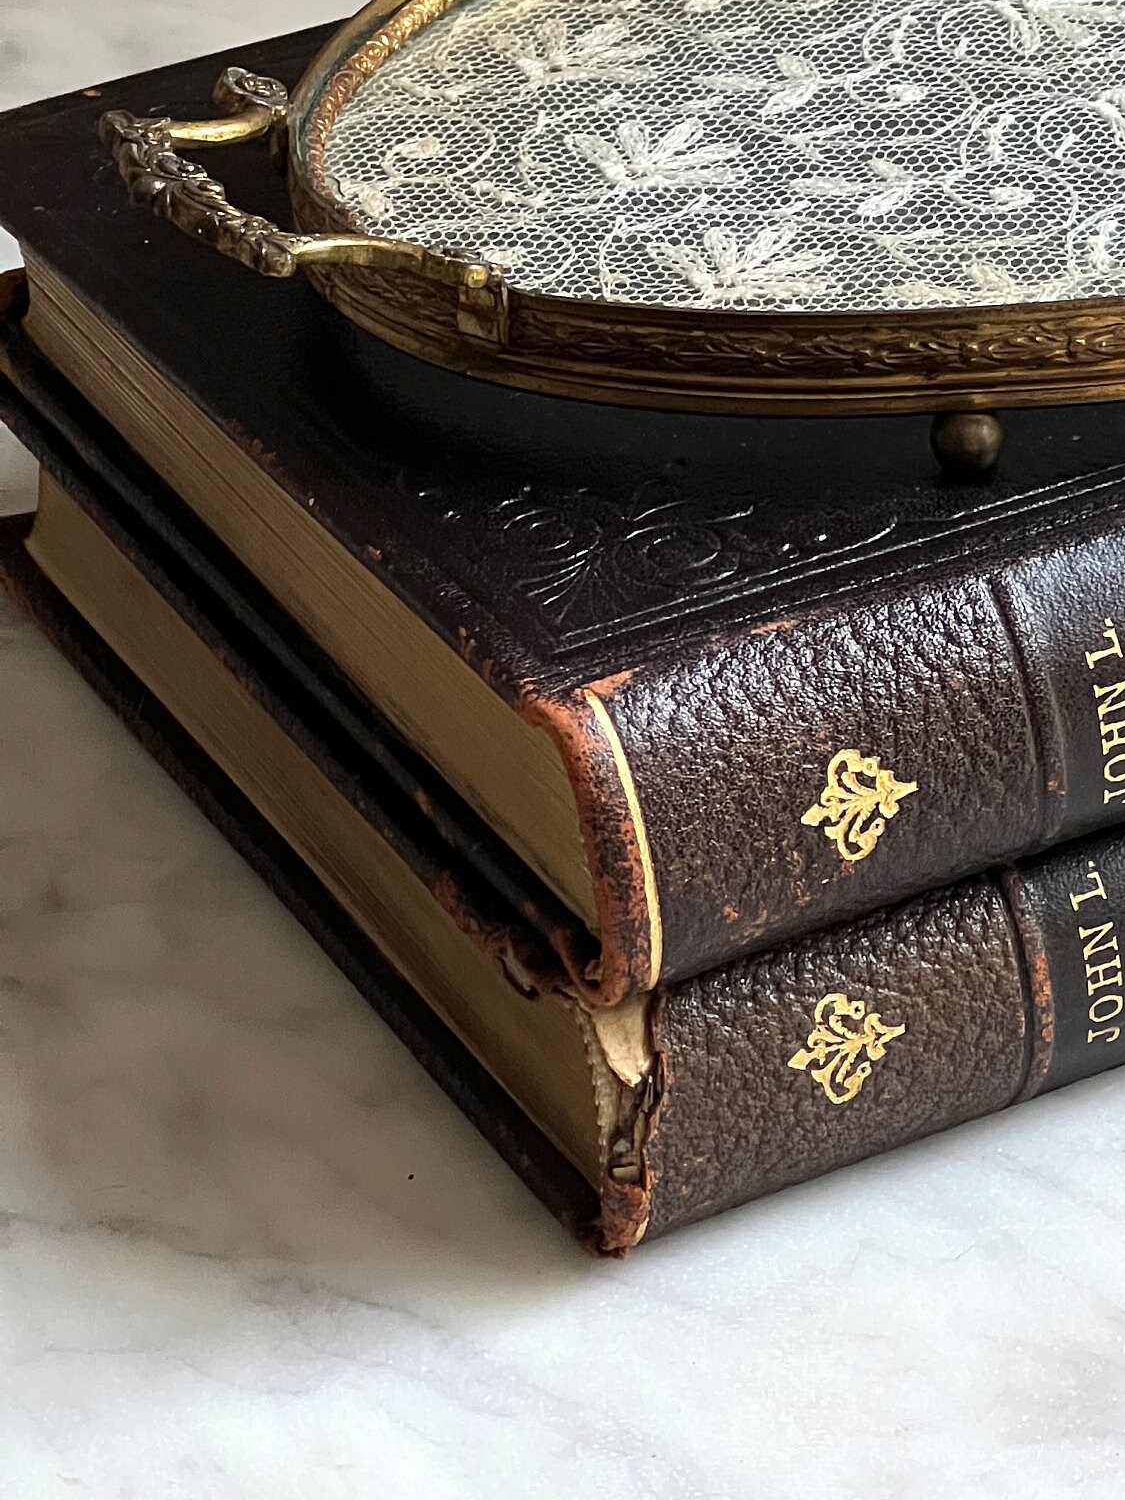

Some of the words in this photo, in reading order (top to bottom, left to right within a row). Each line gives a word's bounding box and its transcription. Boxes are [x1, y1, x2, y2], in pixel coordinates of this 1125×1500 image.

[1086, 617, 1125, 670] L.
[1071, 861, 1108, 912] L.
[1078, 920, 1124, 1045] JOHN
